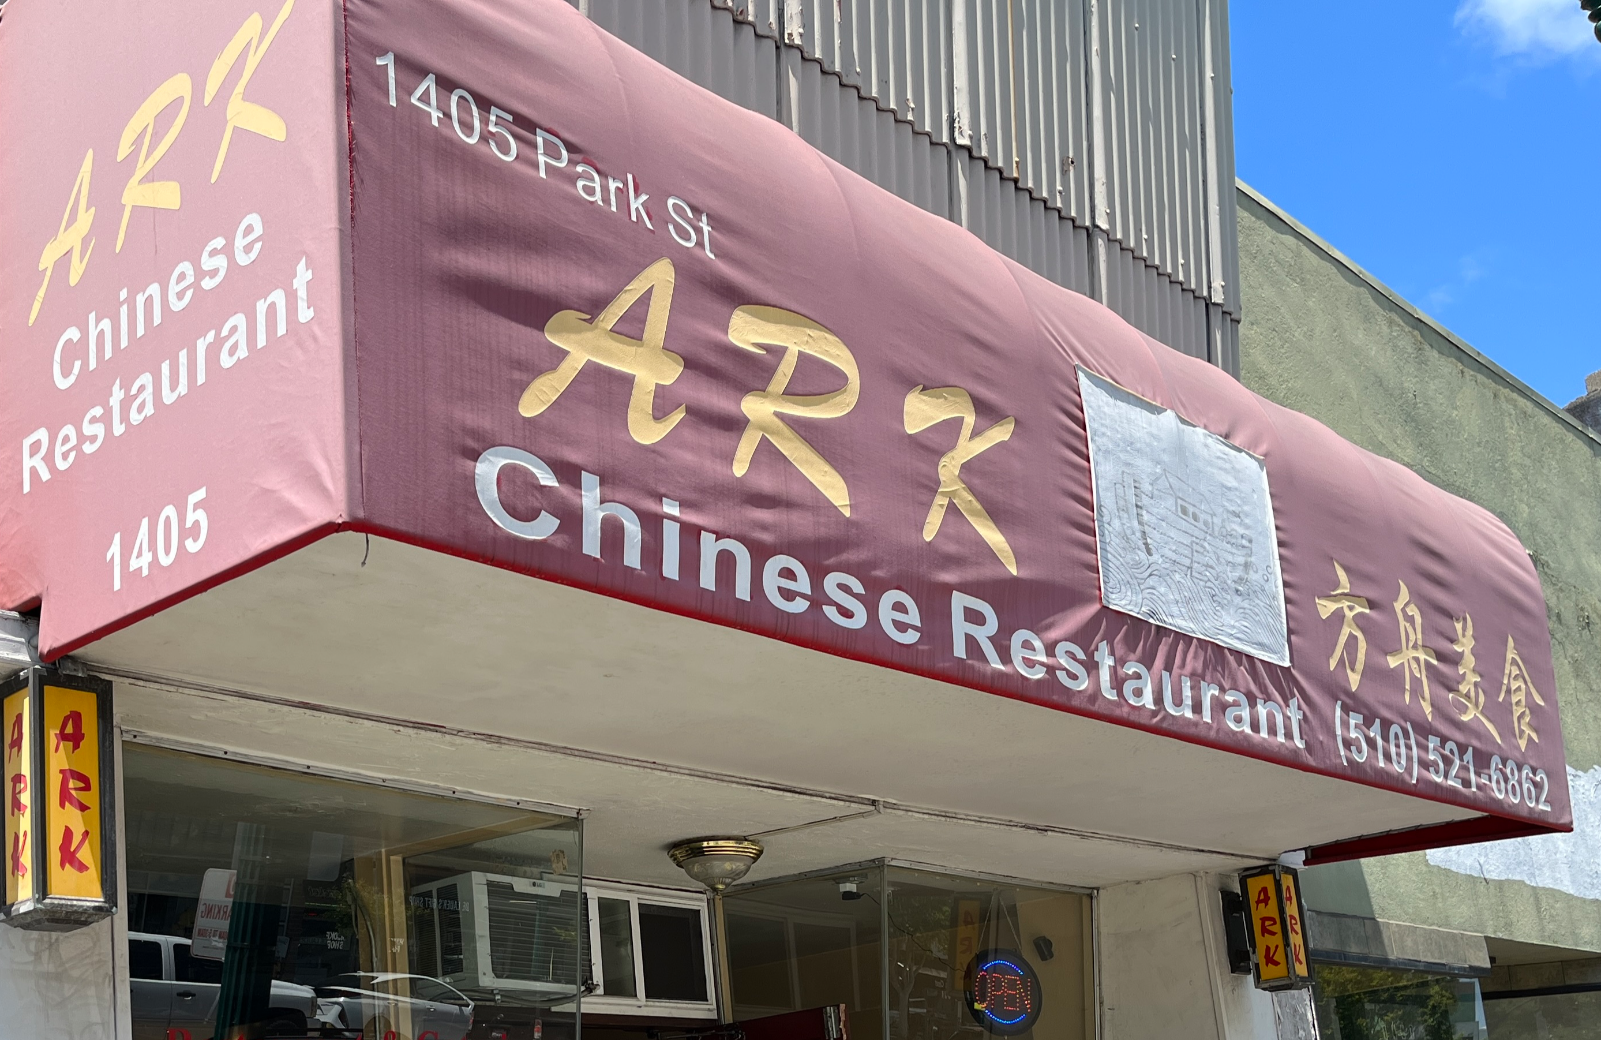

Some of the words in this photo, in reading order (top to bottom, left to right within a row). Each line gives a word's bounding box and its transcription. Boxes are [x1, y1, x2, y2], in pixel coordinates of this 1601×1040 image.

[29, 0, 295, 327] ARK
[376, 51, 517, 162] 1405
[536, 127, 654, 230] Park
[667, 195, 715, 260] St
[22, 255, 314, 494] Restaurant
[53, 212, 263, 390] Chinese
[518, 257, 1018, 576] ARK
[106, 486, 209, 591] 1405
[474, 446, 922, 645] Chinese
[951, 590, 1306, 748] Restaurant
[1315, 558, 1545, 752] 方舟美食
[8, 712, 27, 878] ARK
[55, 710, 92, 874] ARK
[1335, 700, 1418, 784] (510)
[1428, 734, 1551, 811] 521-6862
[975, 971, 1031, 1012] OPEN
[1255, 886, 1281, 967] ARK
[1284, 884, 1304, 966] ARK
